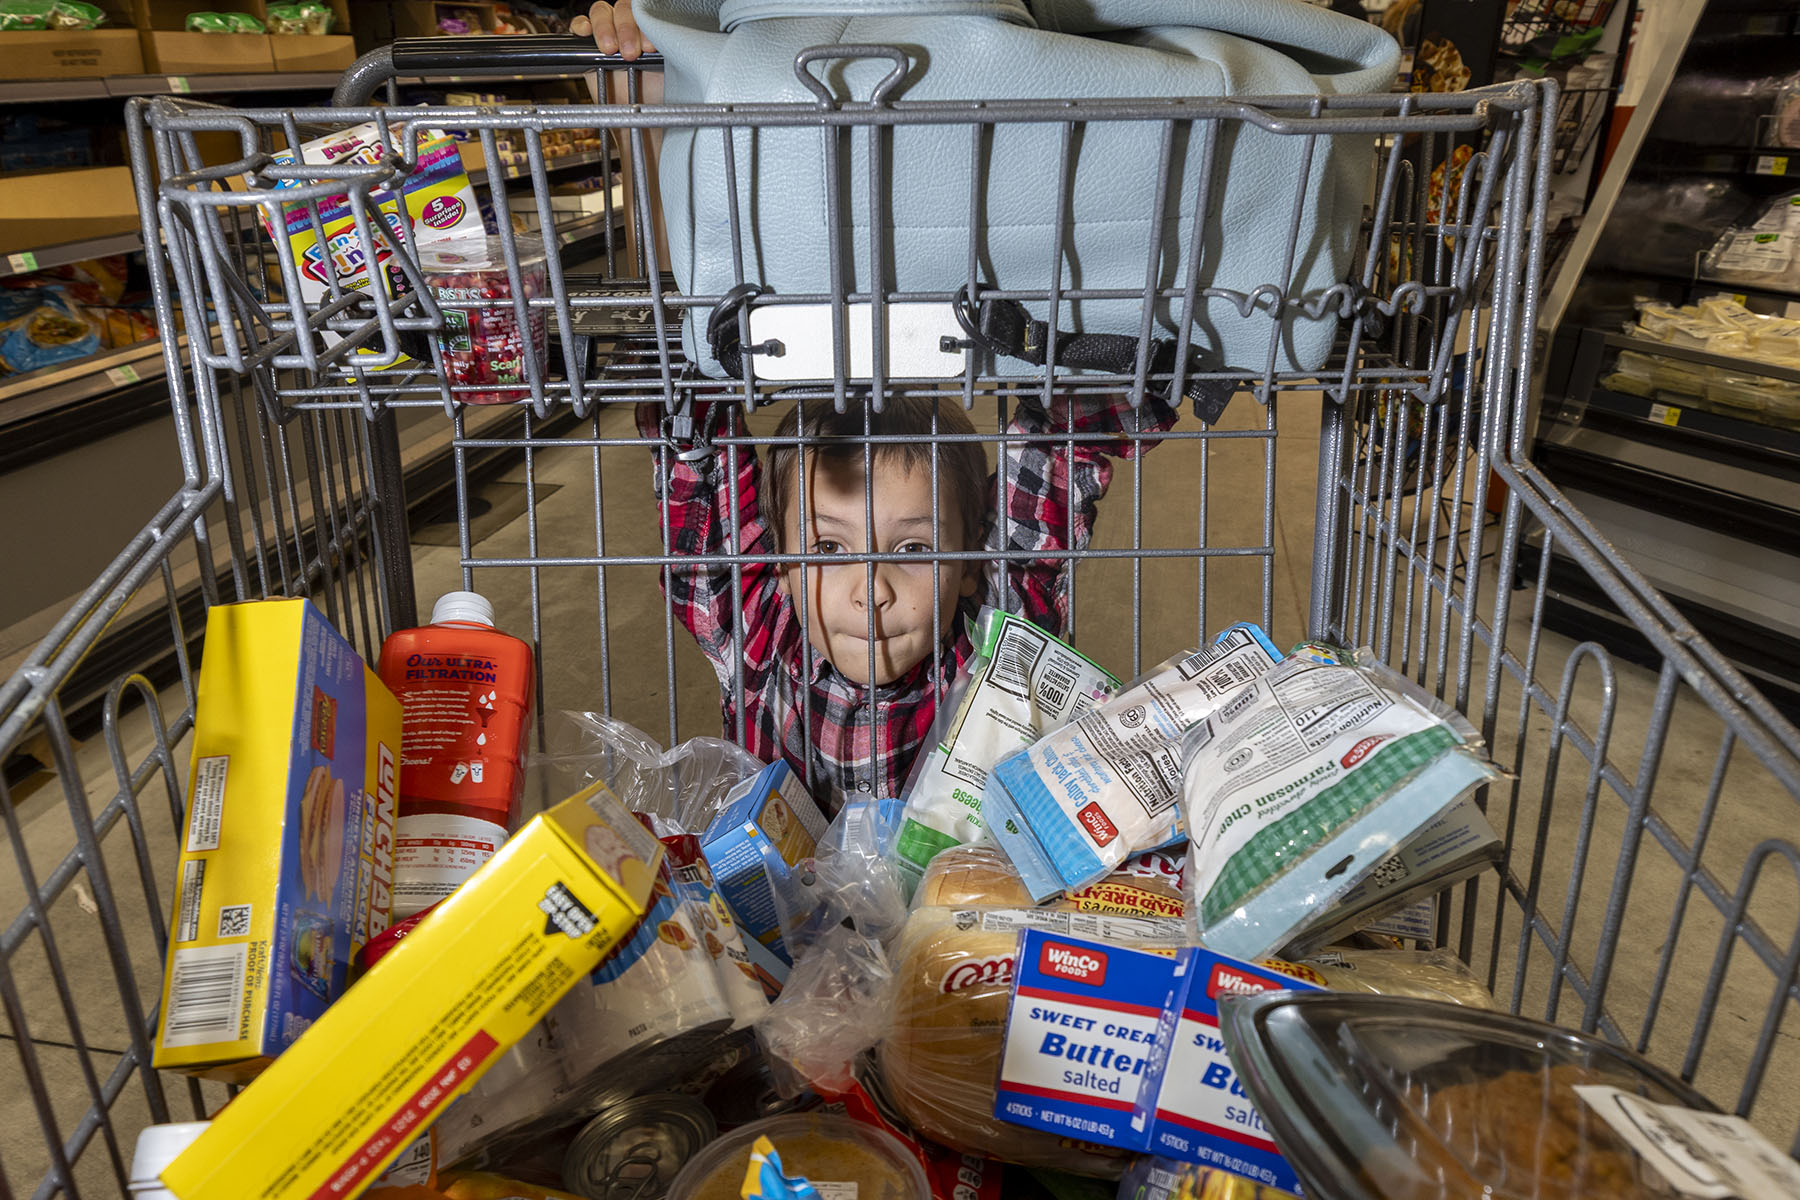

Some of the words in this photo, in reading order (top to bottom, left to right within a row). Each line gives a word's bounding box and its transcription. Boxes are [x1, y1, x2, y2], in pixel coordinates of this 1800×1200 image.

[430, 197, 445, 212] 5
[490, 359, 519, 370] Scan
[498, 373, 520, 383] Me!
[406, 653, 443, 668] Our
[443, 657, 497, 670] ULTRA-
[1225, 662, 1244, 682] SATISFACTION
[1232, 660, 1250, 678] GUARANTEE
[406, 667, 495, 683] FILTRATION
[1042, 672, 1069, 691] SATISFACTION
[1047, 668, 1070, 685] GUARANTEE
[1209, 668, 1234, 690] 100%
[1036, 681, 1065, 706] 100%
[1294, 707, 1319, 727] 110
[1338, 699, 1382, 732] Nutrition
[1049, 762, 1072, 783] Jack
[1117, 756, 1134, 773] Facts
[1158, 752, 1181, 784] alories
[1061, 777, 1089, 807] Colby
[1129, 771, 1159, 807] Nutrition
[1254, 758, 1336, 808] Parmesan
[950, 786, 984, 814] heese
[1255, 785, 1306, 819] shredded
[362, 792, 375, 855] FUN
[1082, 809, 1109, 840] WinCo
[1093, 810, 1109, 829] FOODS
[1212, 803, 1252, 840] Chee
[368, 742, 394, 941] LUNCHAB
[353, 859, 371, 944] PACK!
[1082, 900, 1154, 918] ycamore's
[247, 941, 257, 972] PROOF
[1046, 947, 1100, 972] WinCo
[246, 975, 254, 987] OF
[1055, 963, 1087, 977] FOODS
[1216, 971, 1265, 996] WinC
[239, 990, 252, 1041] PURCHASE
[1029, 1006, 1096, 1032] SWEET
[1102, 1023, 1156, 1046] CREA
[1038, 1031, 1150, 1076] Butter
[1062, 1066, 1121, 1094] salted
[1009, 1103, 1033, 1118] STICKS
[1039, 1109, 1055, 1123] NET
[1053, 1112, 1066, 1125] WT
[1223, 1104, 1274, 1133] salt
[1164, 1134, 1190, 1152] STICKS
[1195, 1145, 1213, 1161] NET
[1210, 1150, 1225, 1164] WT
